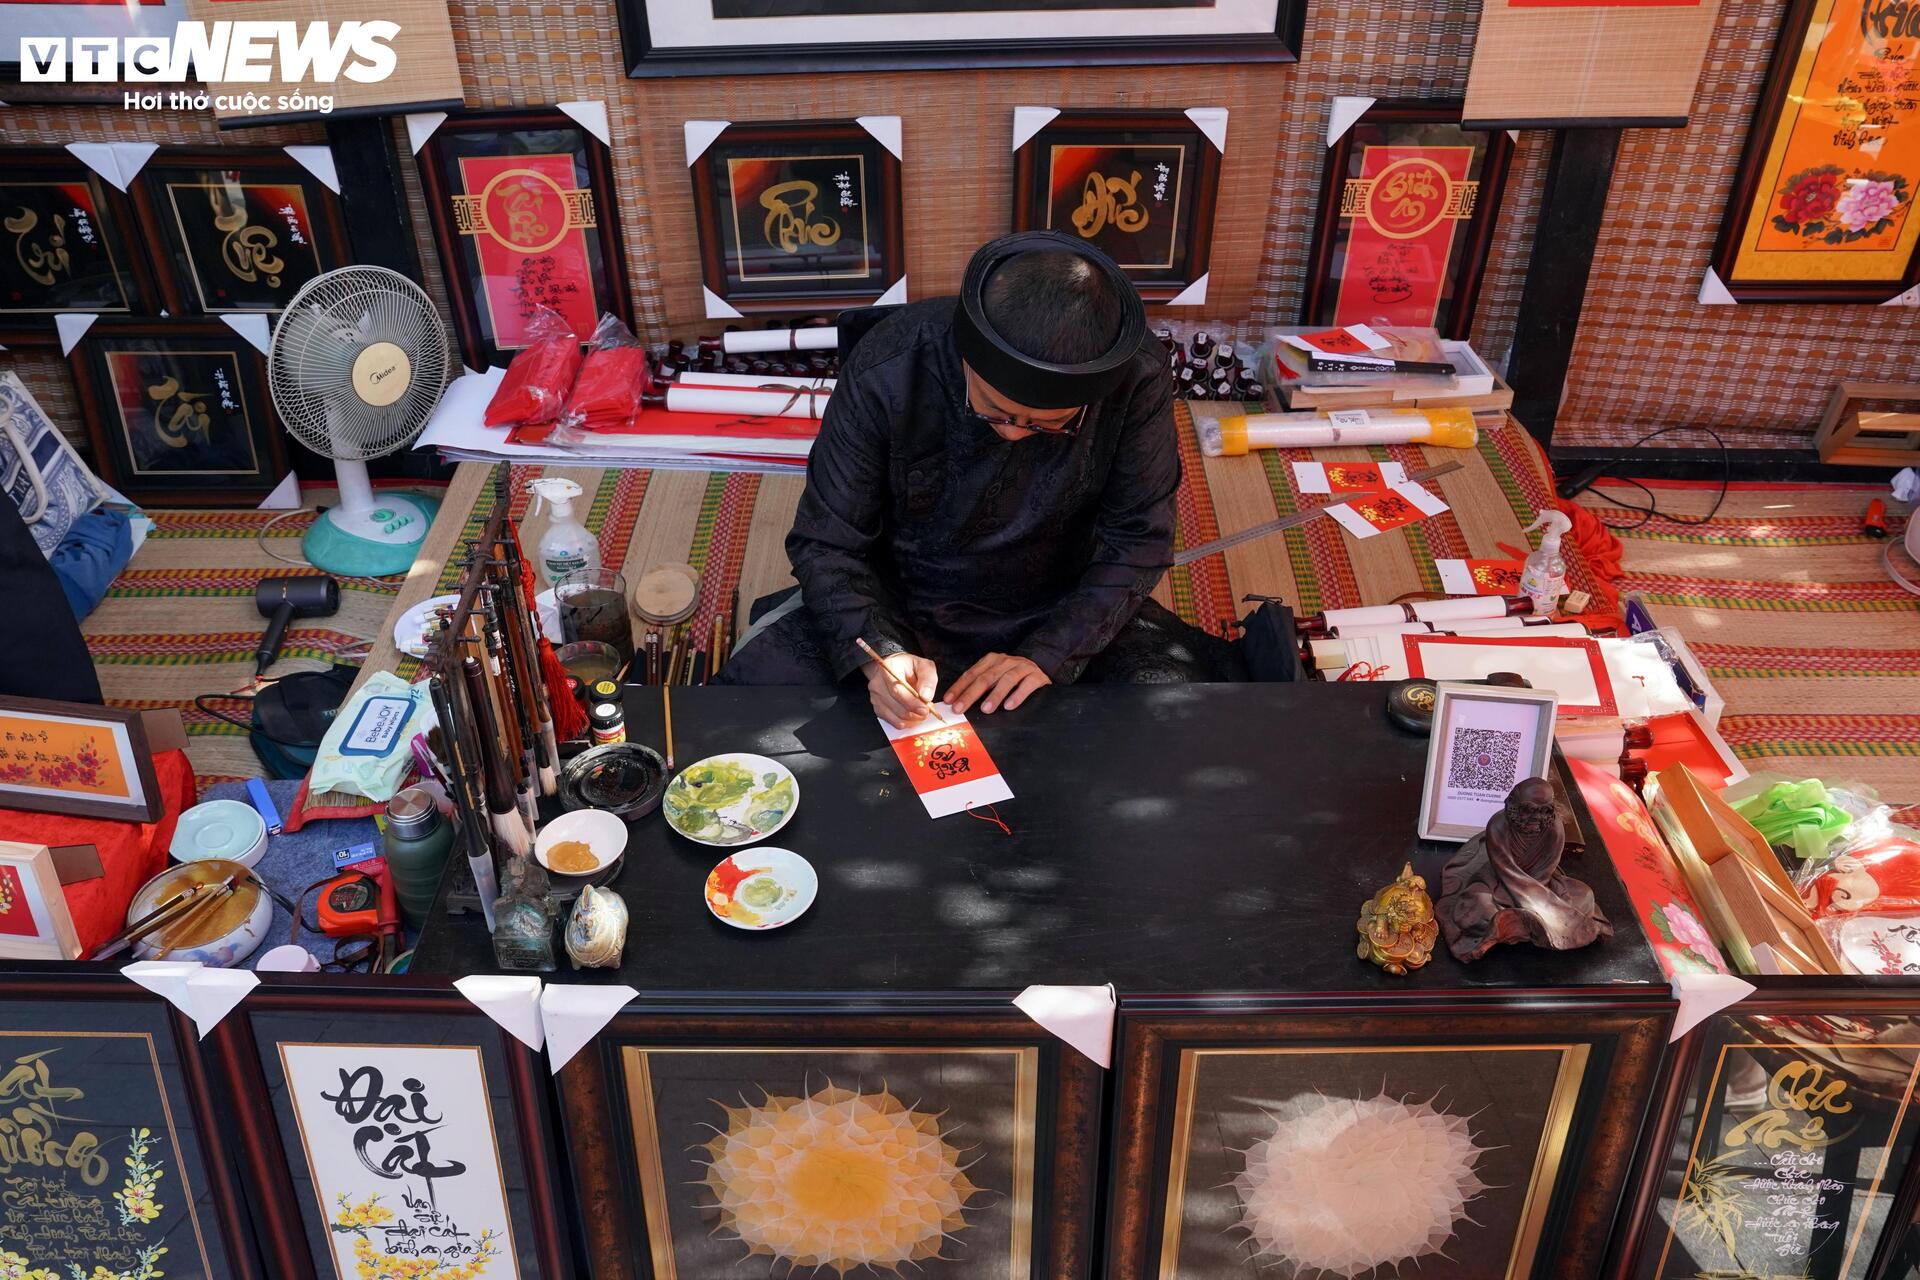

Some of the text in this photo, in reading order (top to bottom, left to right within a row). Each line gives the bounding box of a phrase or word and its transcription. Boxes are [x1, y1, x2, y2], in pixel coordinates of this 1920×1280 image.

[373, 366, 396, 382] Midea
[320, 1066, 443, 1133] Đại
[353, 1125, 466, 1205] Cát
